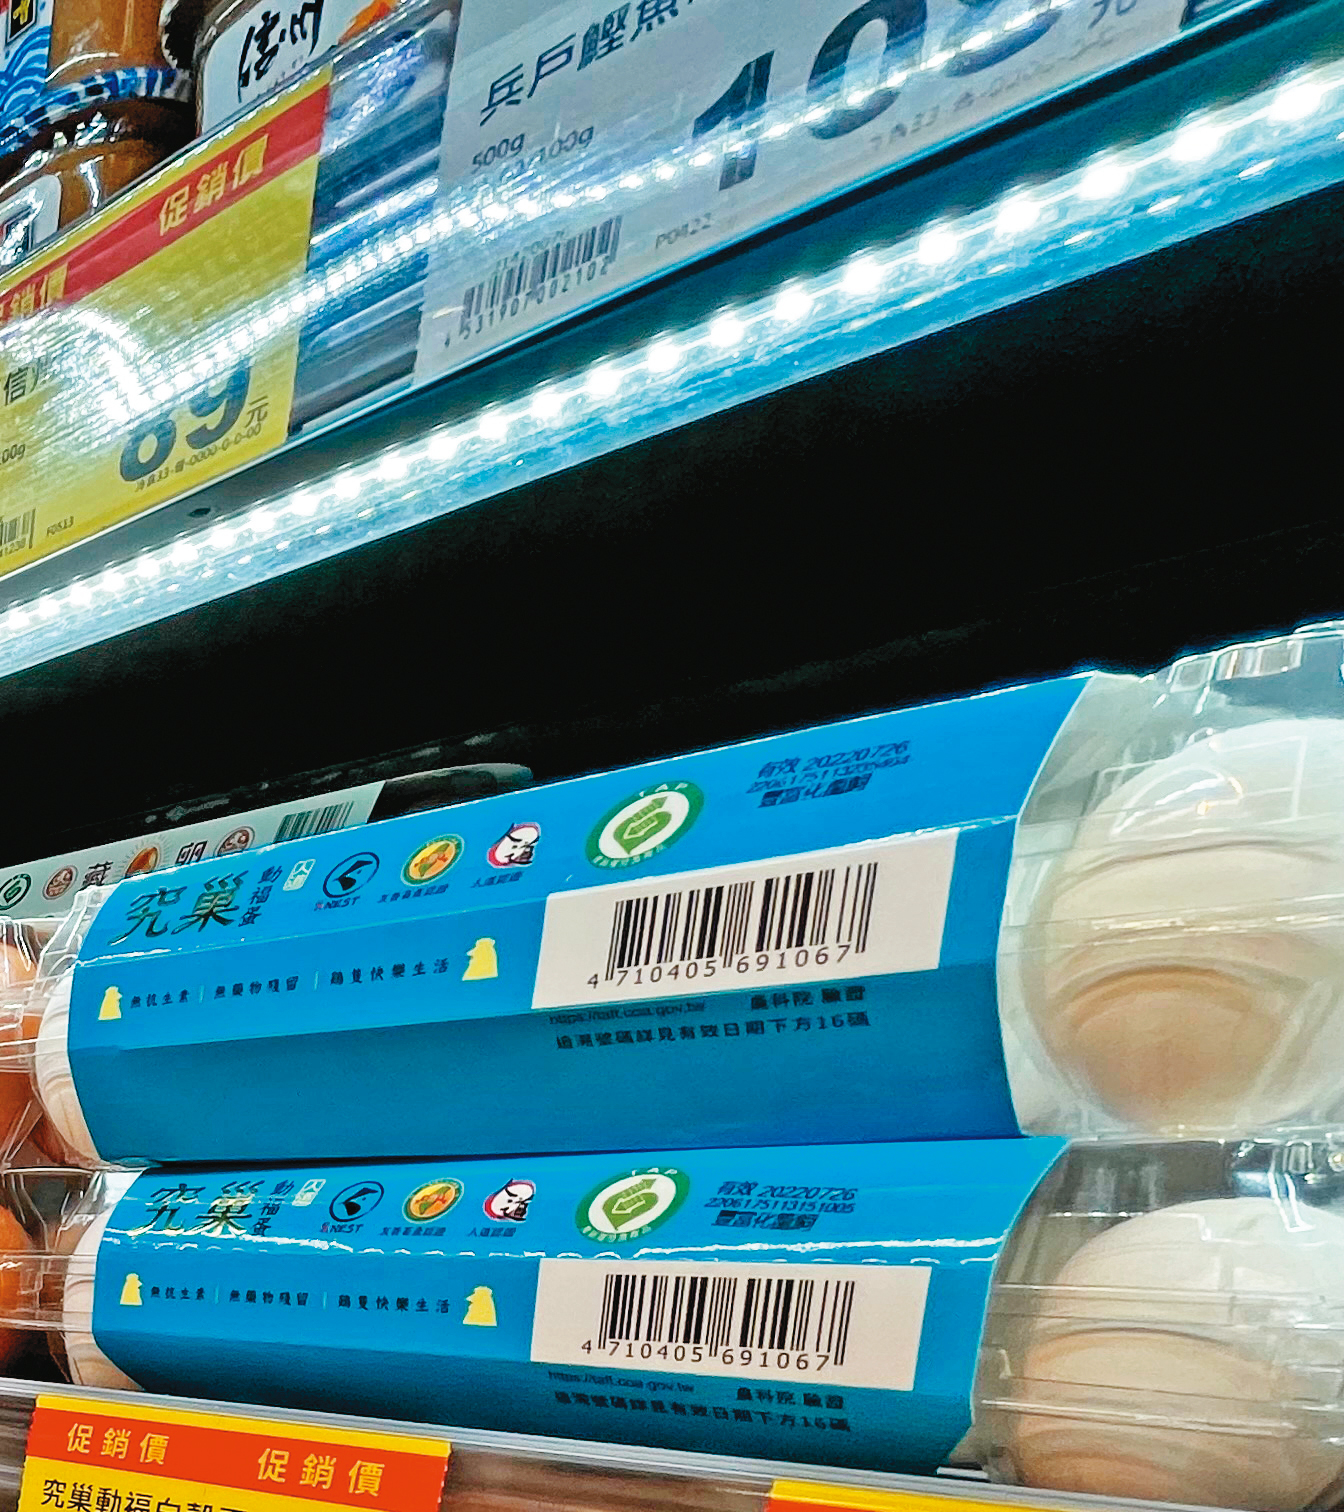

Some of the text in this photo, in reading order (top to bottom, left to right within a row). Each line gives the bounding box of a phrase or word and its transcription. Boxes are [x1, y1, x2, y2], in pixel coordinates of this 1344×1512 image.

[159, 136, 268, 236] 促銷價
[67, 1423, 386, 1497] 促銷價 促銷價
